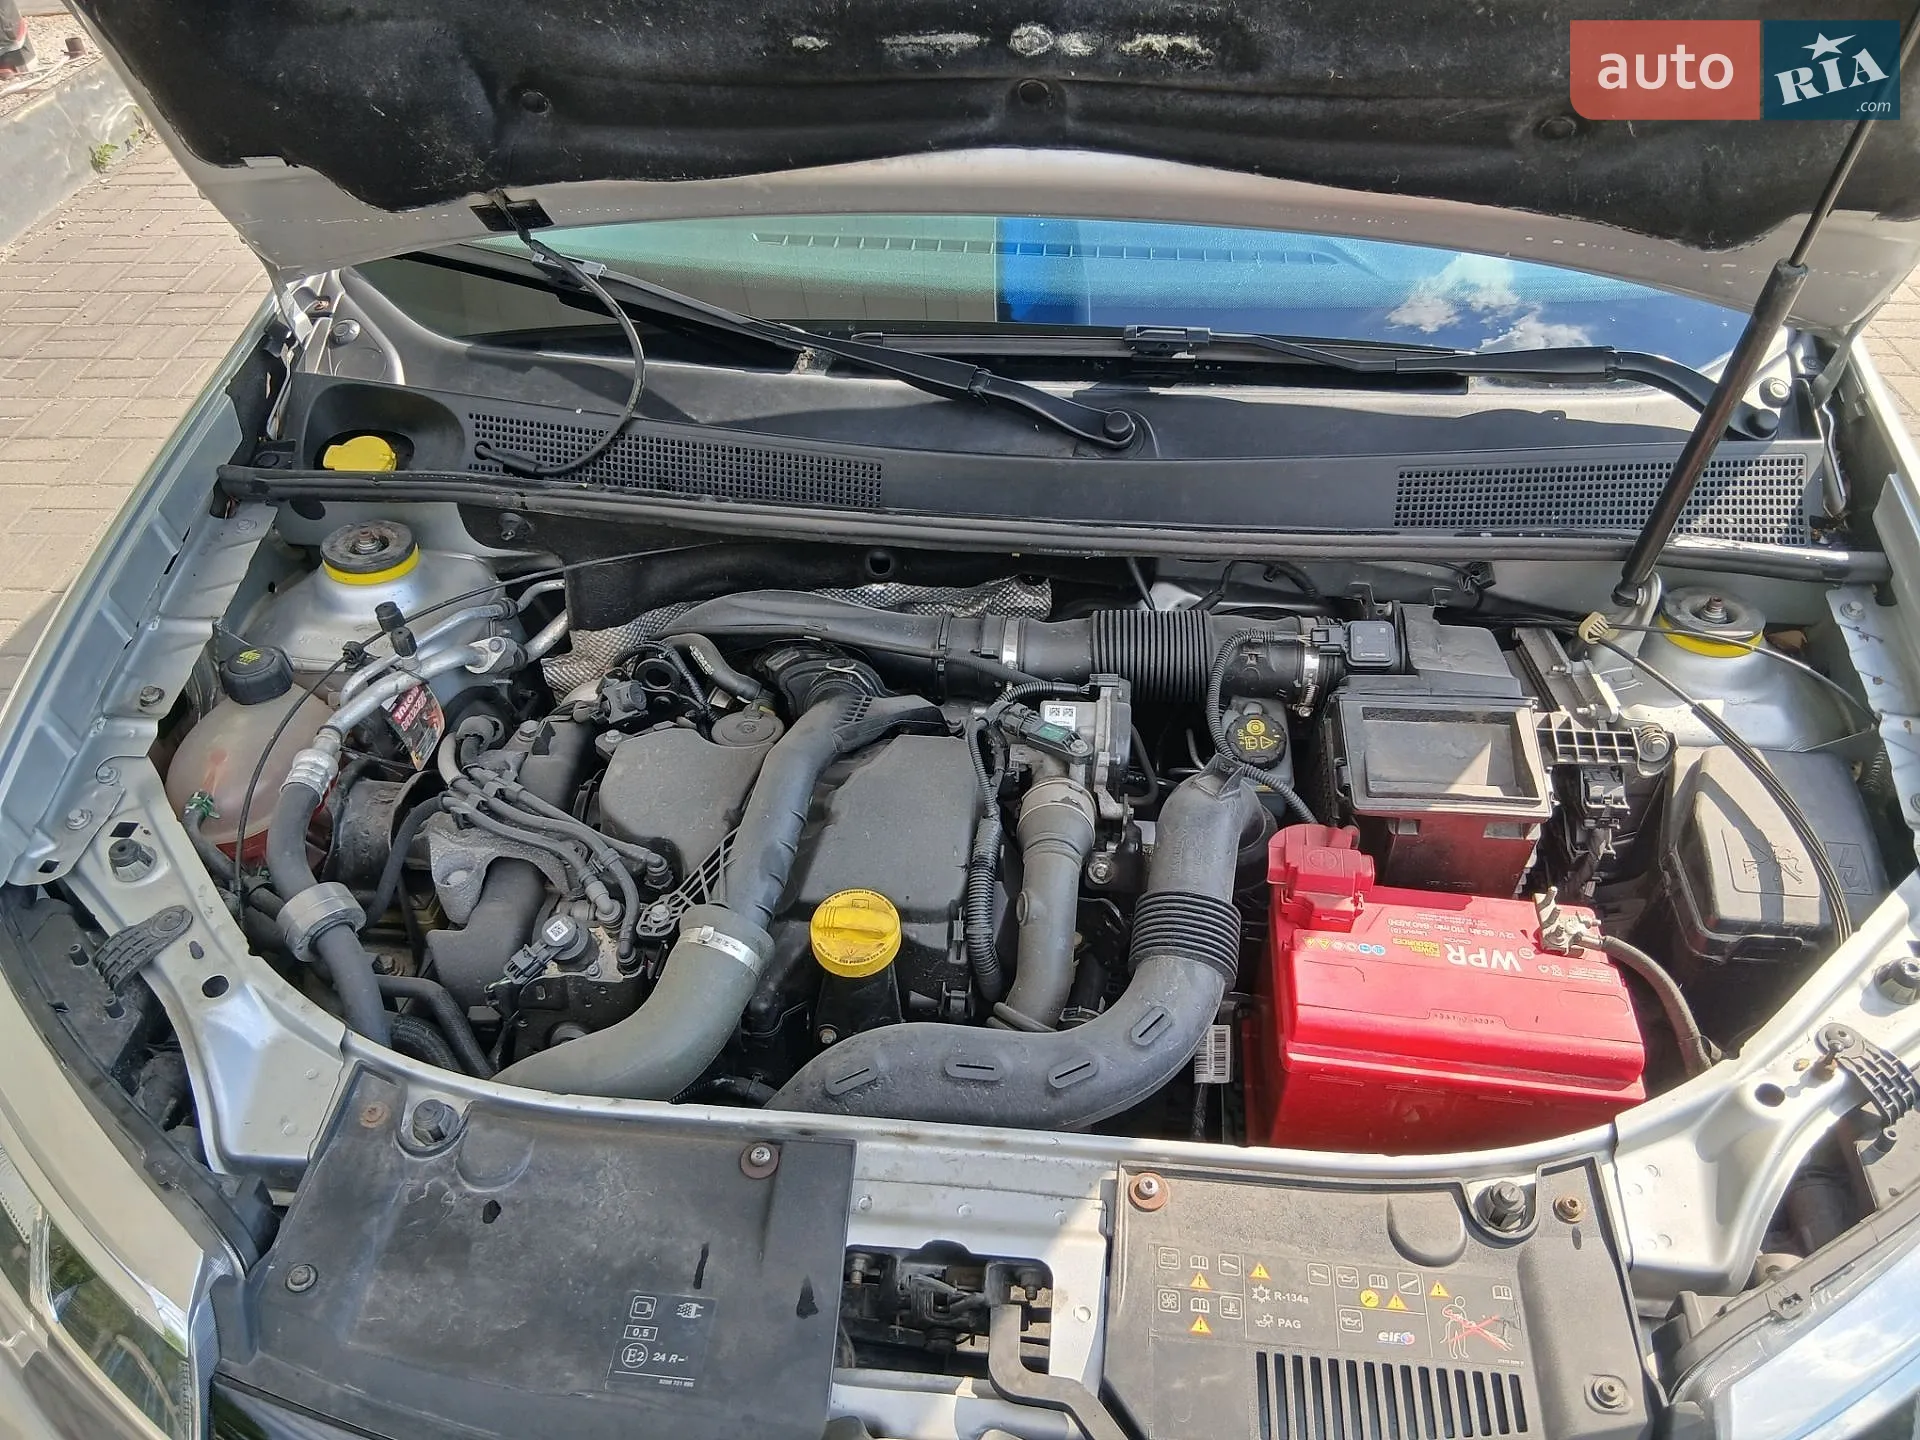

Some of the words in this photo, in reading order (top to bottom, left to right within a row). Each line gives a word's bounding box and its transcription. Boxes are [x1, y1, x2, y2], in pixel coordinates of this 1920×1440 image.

[1444, 943, 1522, 973] WPR
[1274, 1291, 1309, 1304] R-134a
[1277, 1318, 1301, 1329] PAG
[653, 1353, 666, 1362] 24
